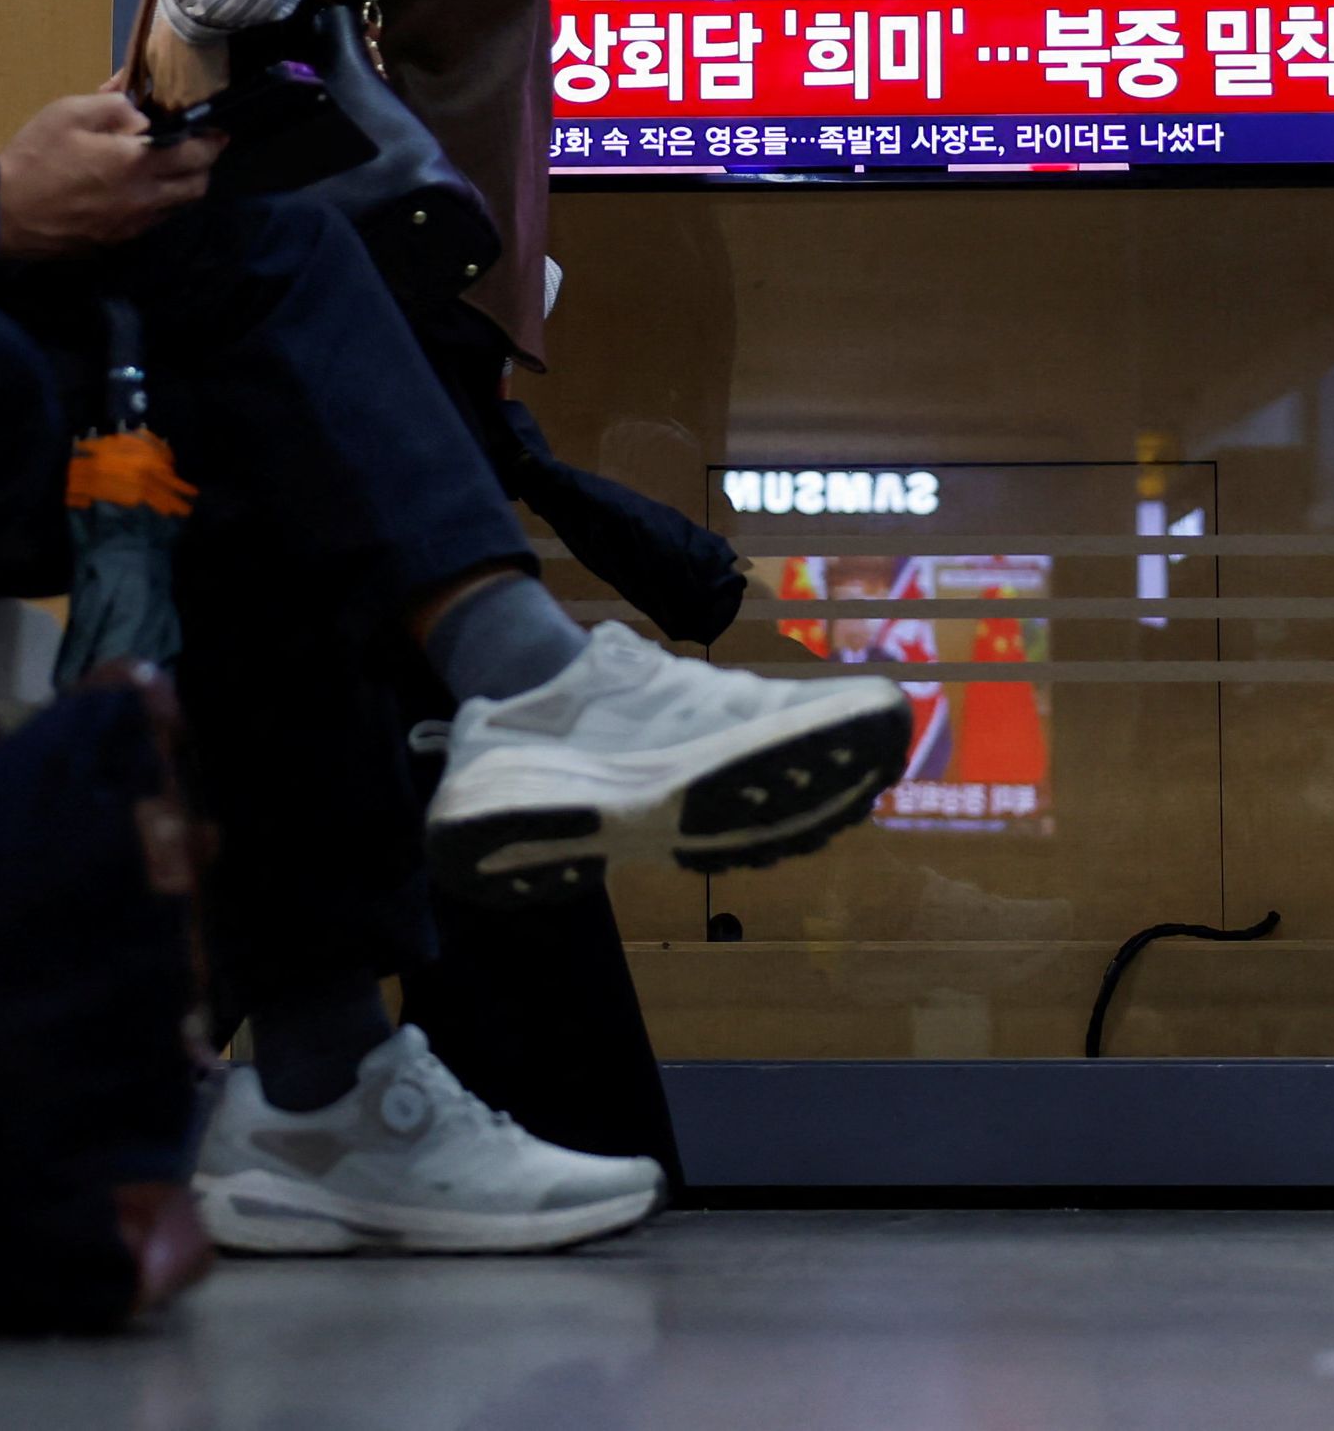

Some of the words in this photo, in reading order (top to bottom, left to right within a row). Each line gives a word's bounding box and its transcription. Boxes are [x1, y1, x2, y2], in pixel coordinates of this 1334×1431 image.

[551, 12, 763, 103] 상회담
[601, 126, 630, 156] 속
[639, 126, 695, 156] 작은
[911, 124, 1006, 156] 사장도,
[1015, 123, 1129, 154] 라이더도
[1140, 122, 1225, 153] 나섰다
